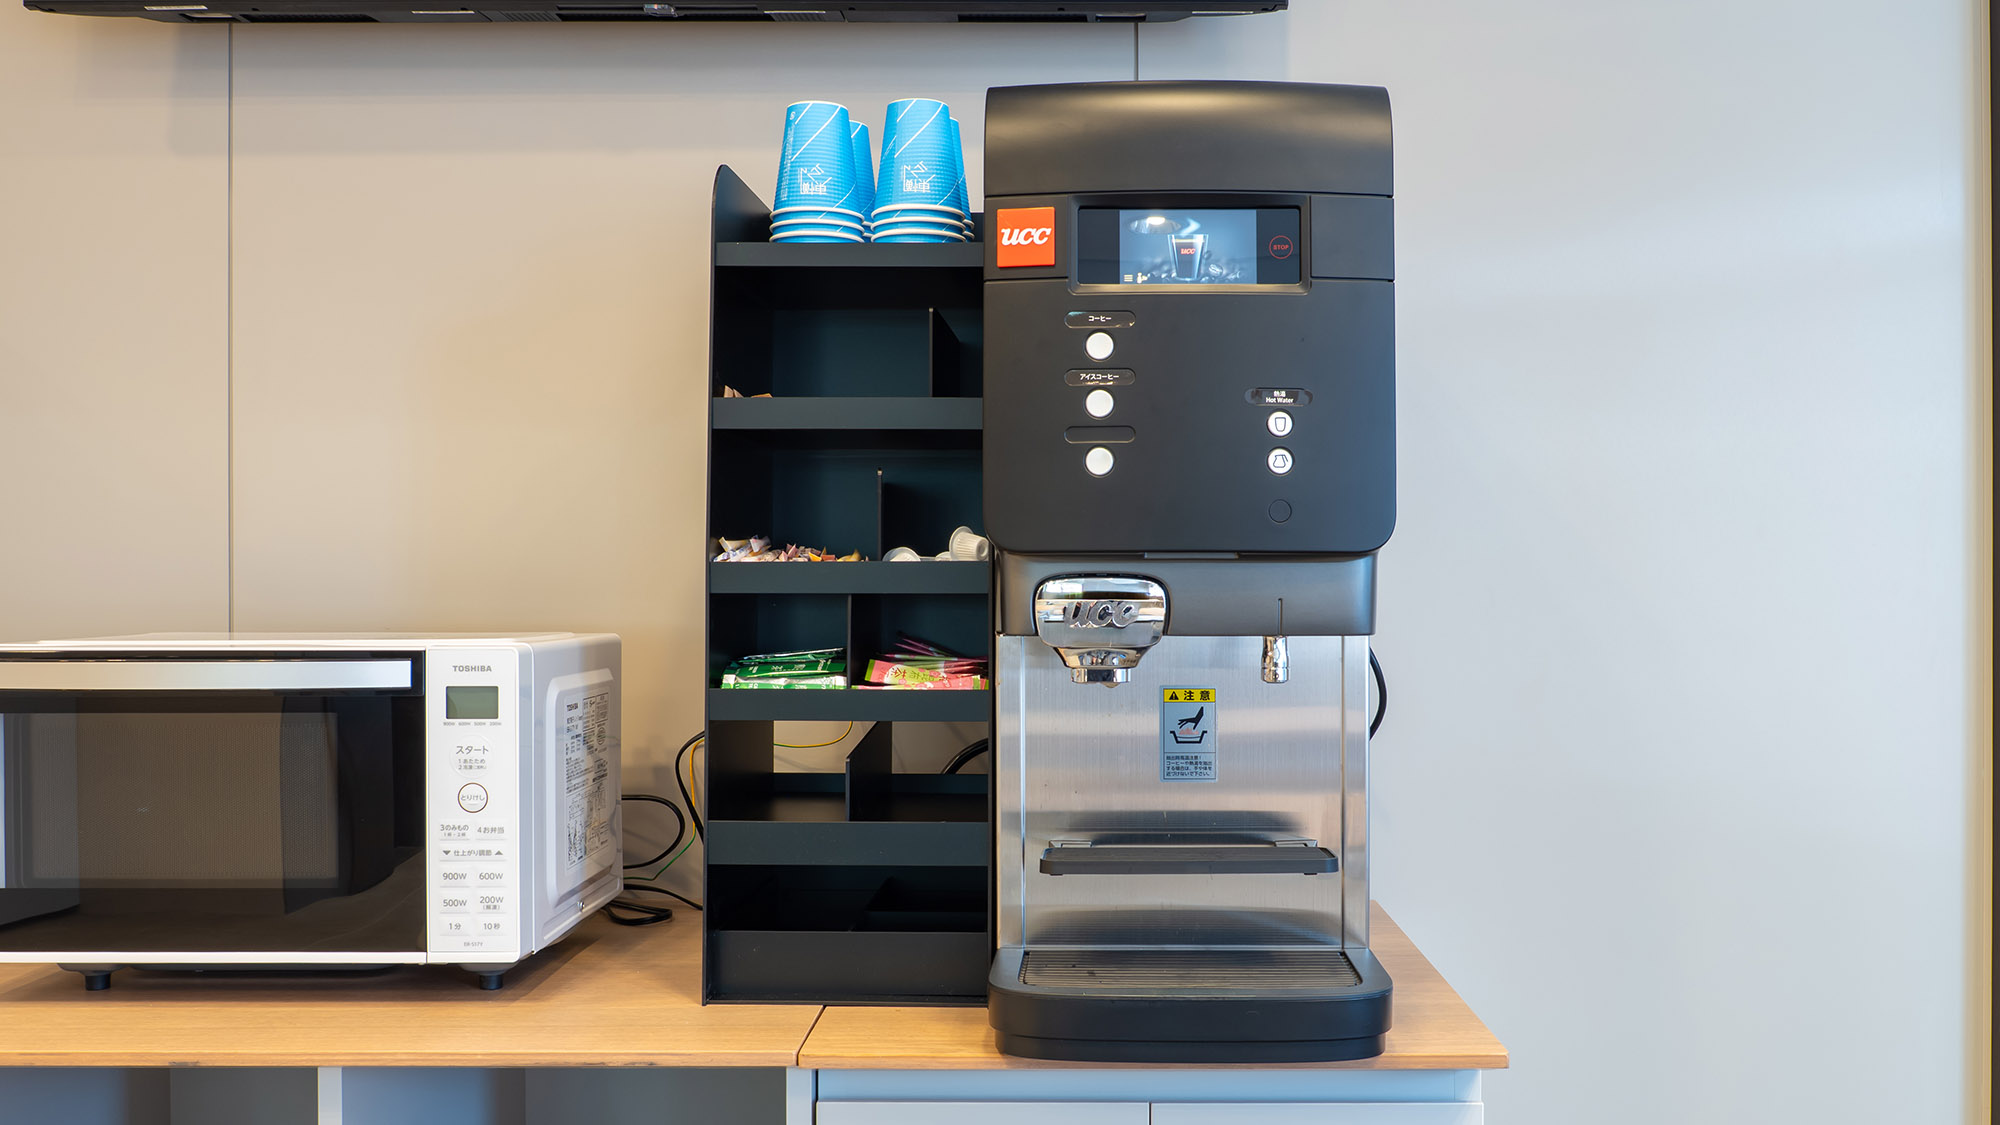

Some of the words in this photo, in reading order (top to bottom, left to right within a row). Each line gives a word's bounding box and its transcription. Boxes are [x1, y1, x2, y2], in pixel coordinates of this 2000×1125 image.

[1079, 373, 1120, 381] アイスコーヒー
[1183, 690, 1210, 701] 注意
[455, 745, 489, 755] スタート
[440, 824, 470, 832] 3のみもの
[453, 849, 493, 857] 仕上がり調節
[442, 872, 467, 881] 900W
[478, 872, 504, 881] 600W
[443, 899, 467, 907] 500W
[479, 895, 504, 904] 200W
